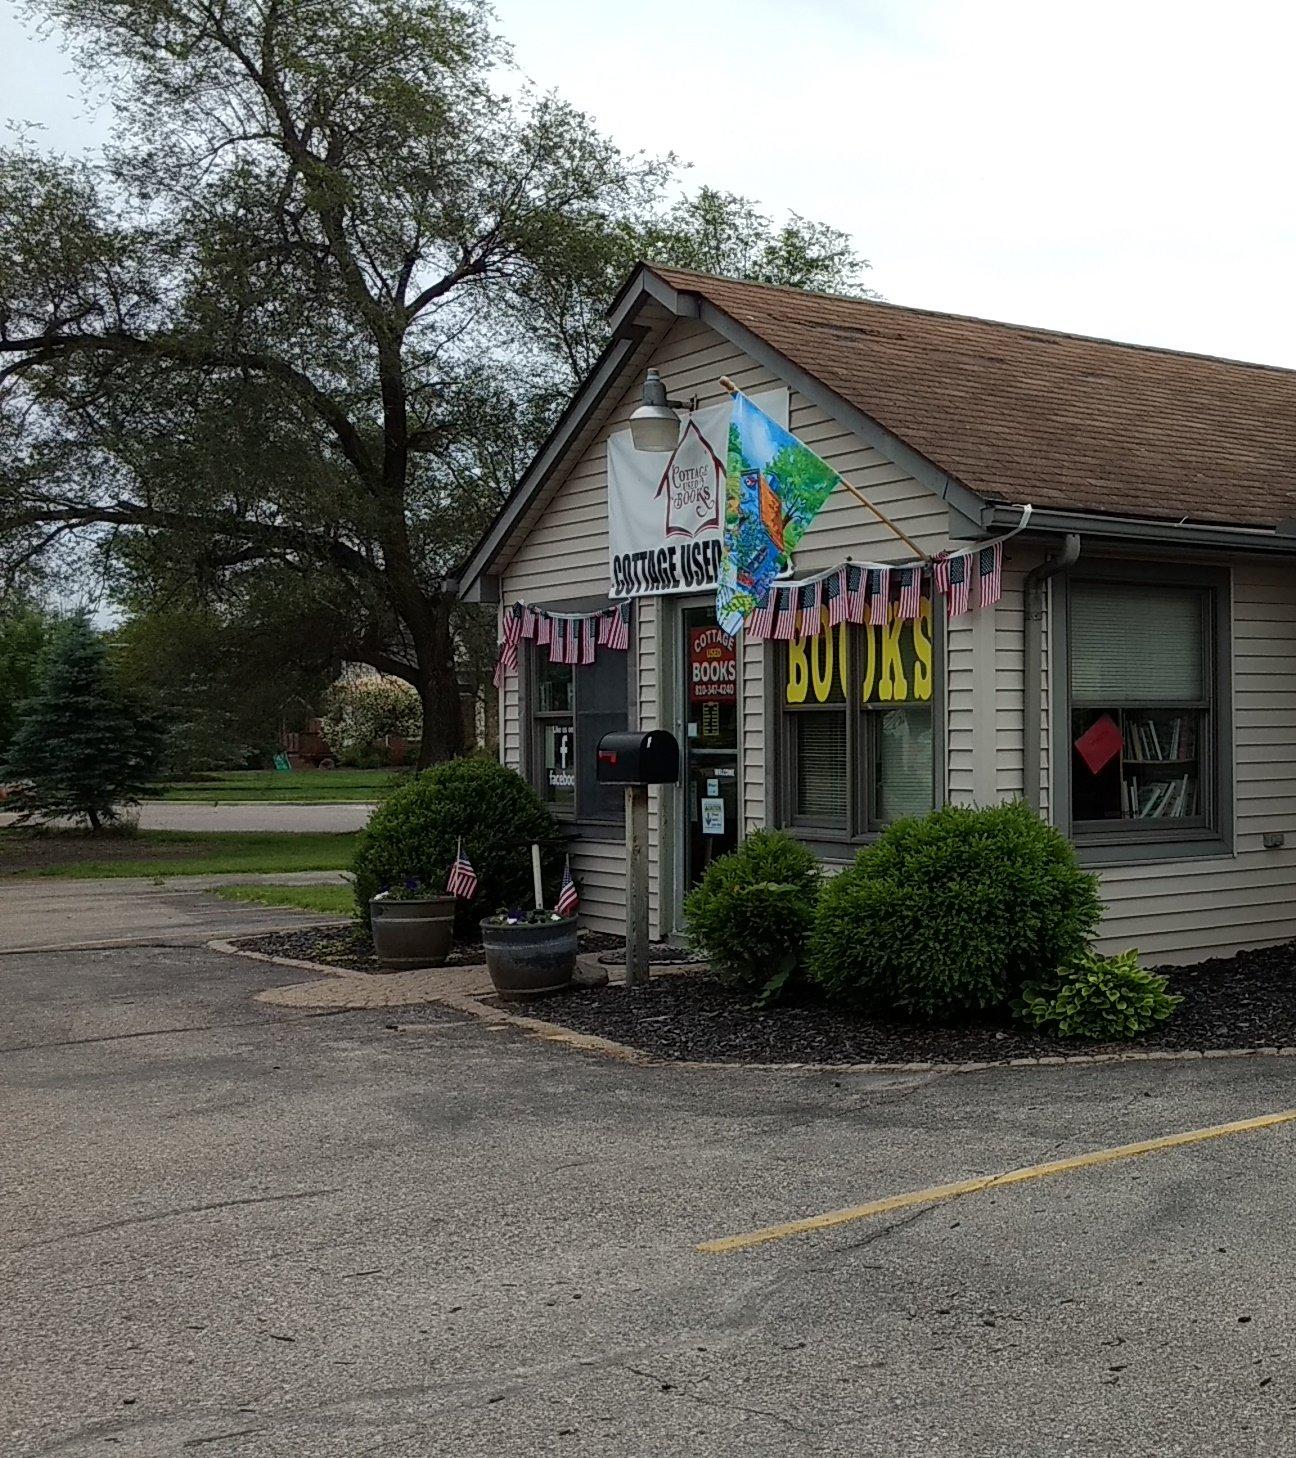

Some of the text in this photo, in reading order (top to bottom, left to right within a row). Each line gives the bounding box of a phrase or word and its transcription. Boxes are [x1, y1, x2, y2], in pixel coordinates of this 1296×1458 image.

[672, 486, 715, 517] BOOKS
[613, 539, 722, 596] COTTAGE USED
[694, 629, 735, 653] COTTAGE
[706, 648, 721, 658] USED
[692, 660, 736, 682] BOOKS
[549, 769, 575, 786] faceboo
